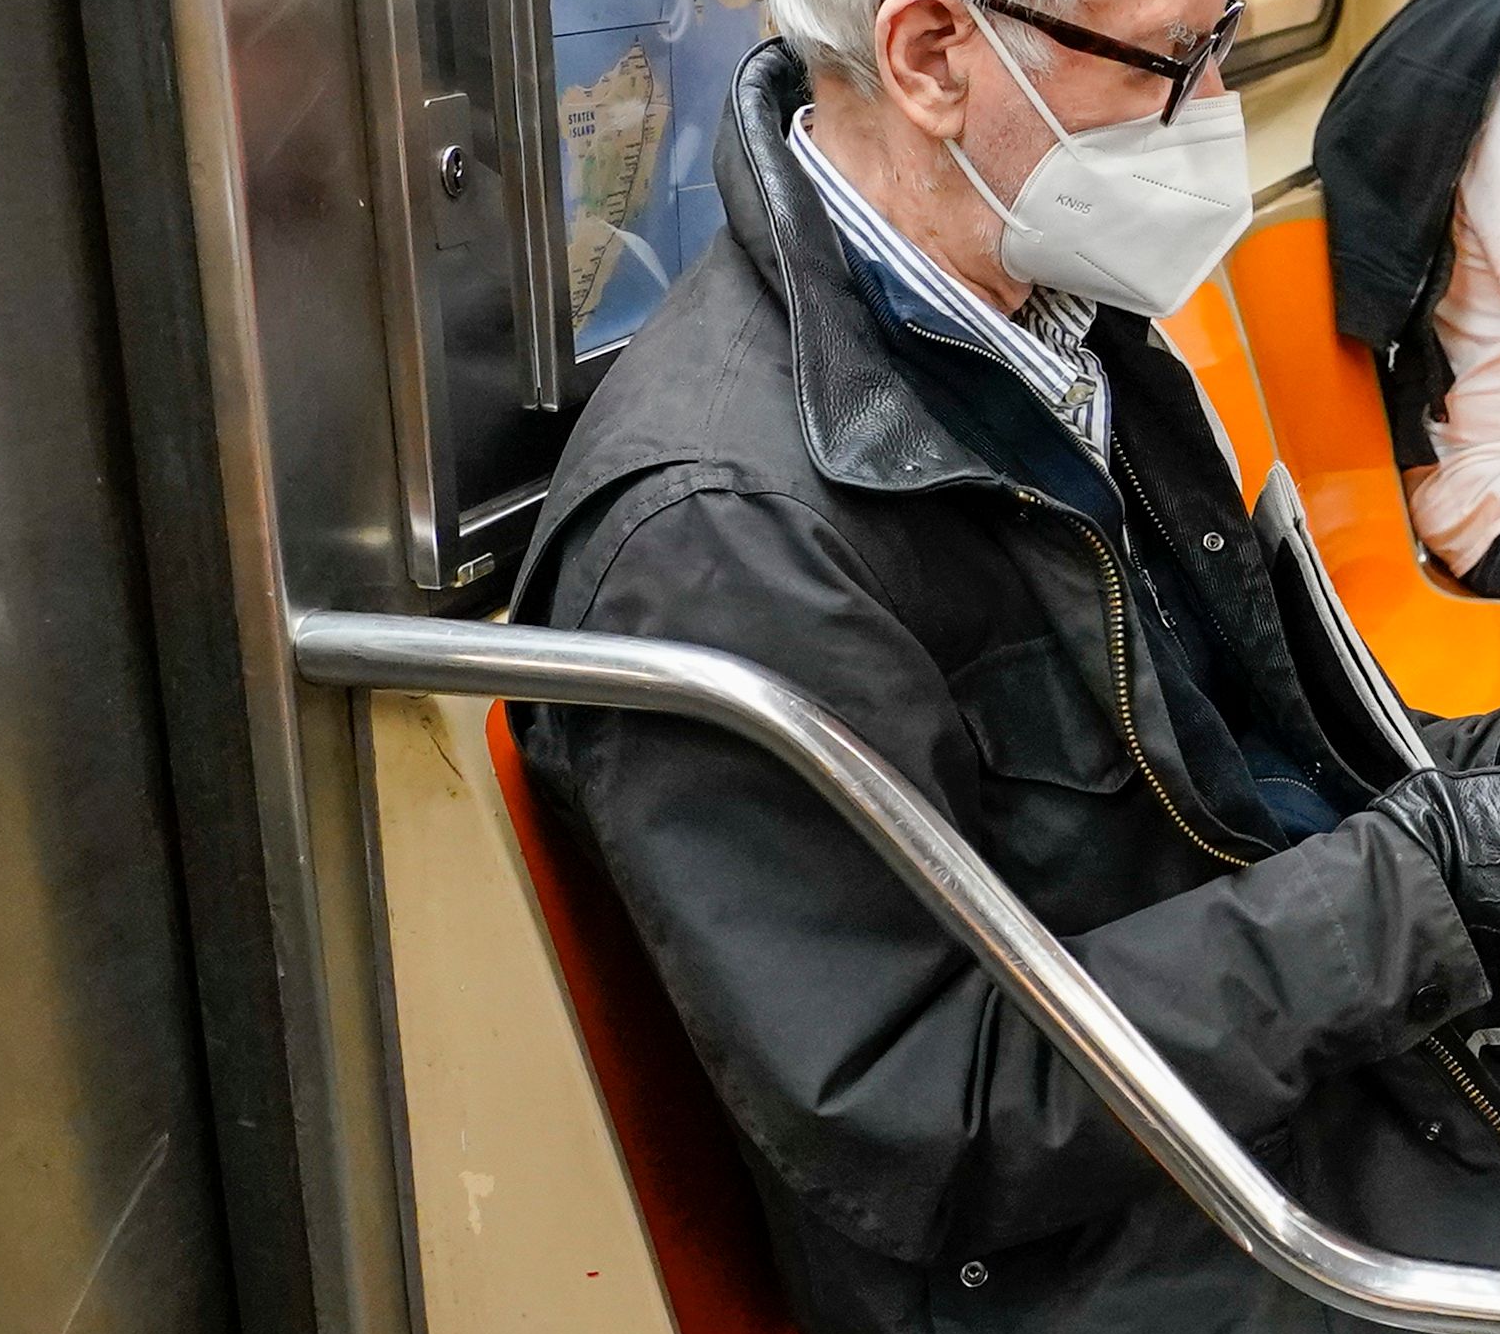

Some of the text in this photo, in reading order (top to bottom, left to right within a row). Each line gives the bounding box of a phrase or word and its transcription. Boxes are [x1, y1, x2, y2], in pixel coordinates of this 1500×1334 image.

[568, 111, 595, 125] STATEN
[569, 124, 595, 138] ISLAND
[1055, 193, 1092, 215] KN95
